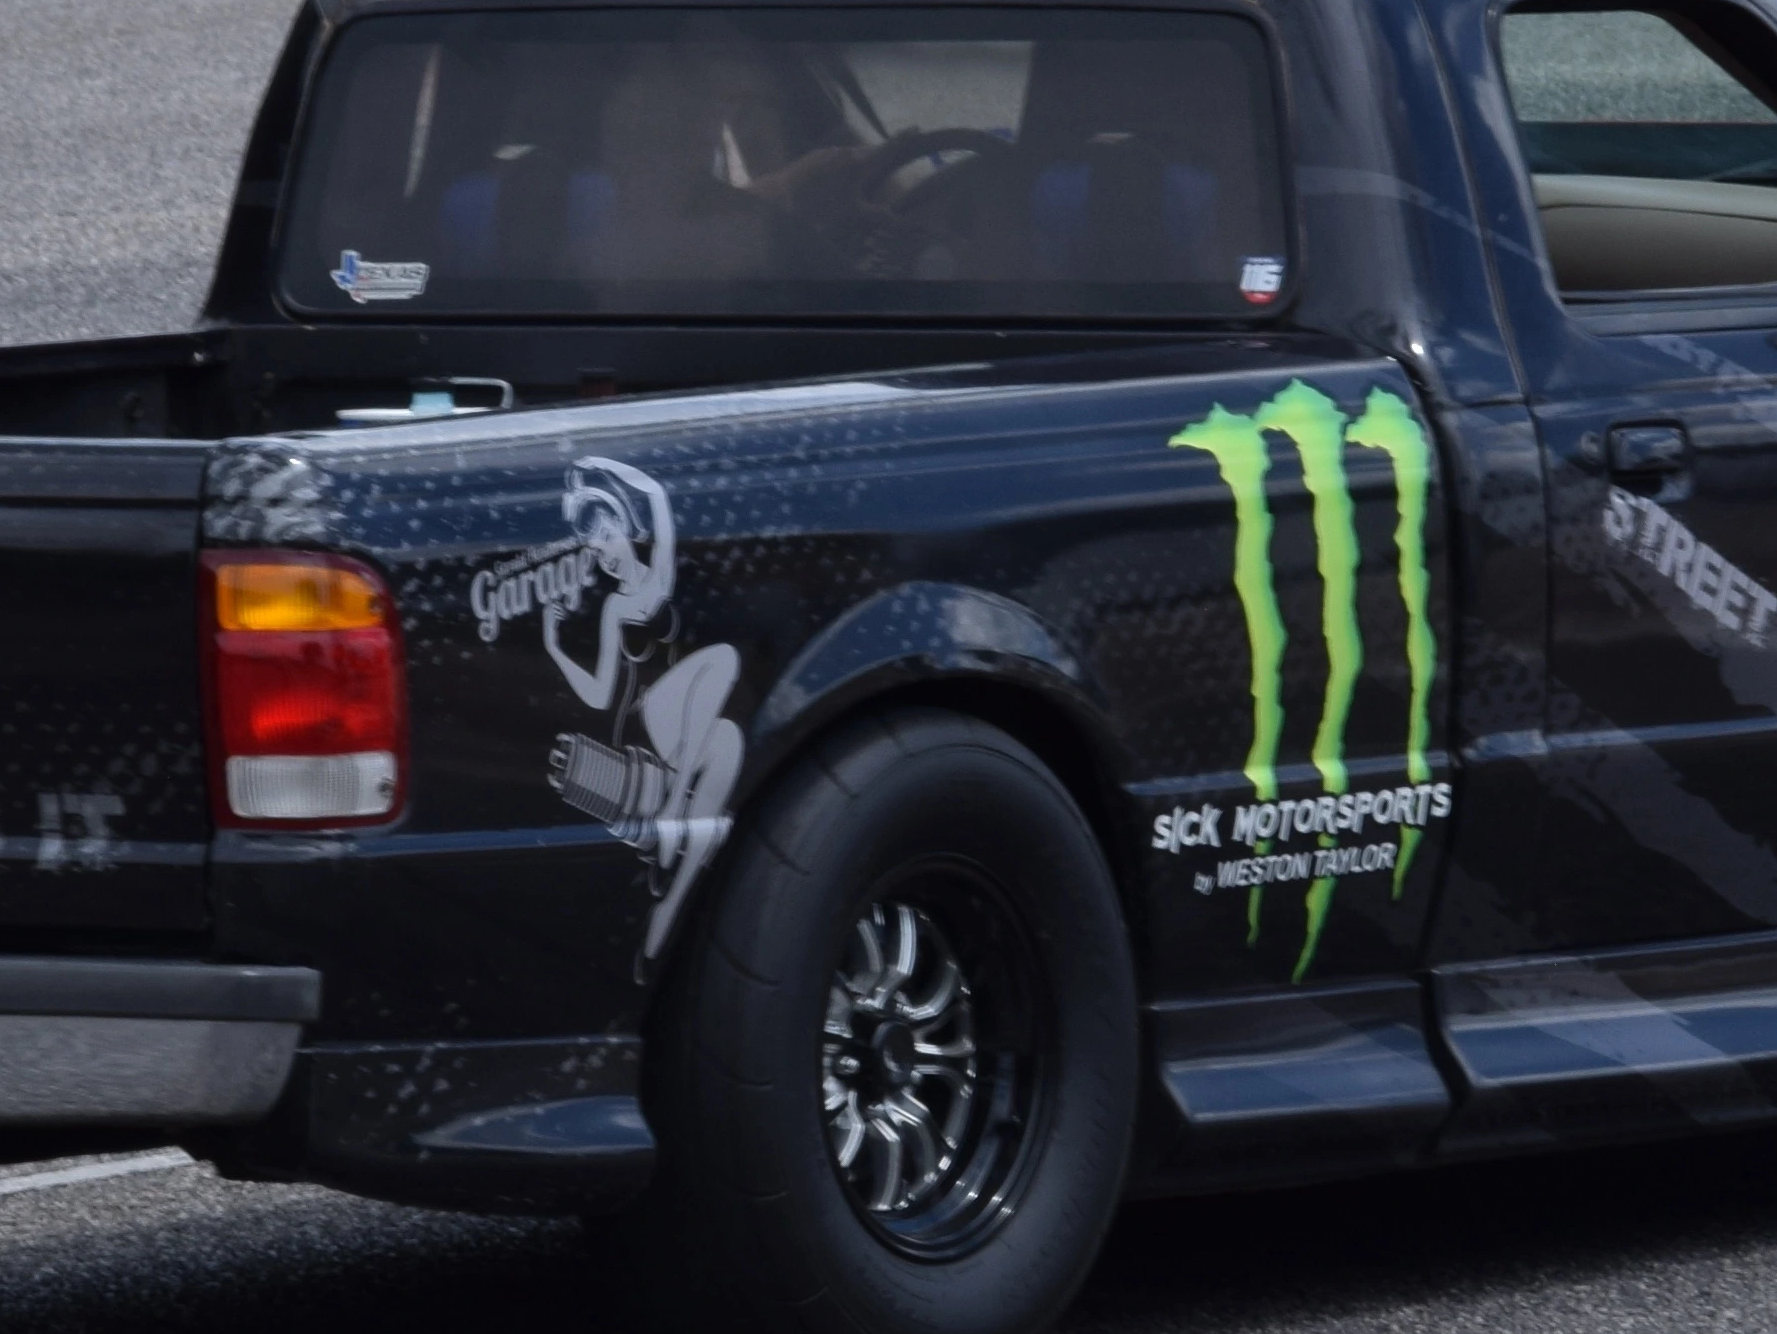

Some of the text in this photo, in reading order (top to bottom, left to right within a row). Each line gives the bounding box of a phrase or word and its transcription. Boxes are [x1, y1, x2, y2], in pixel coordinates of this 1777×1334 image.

[470, 547, 599, 643] Garage
[34, 789, 125, 873] IT
[1151, 782, 1453, 854] SICK MOTORSPORTS
[1216, 851, 1312, 889] WESTON
[1312, 842, 1397, 877] TAYLOR
